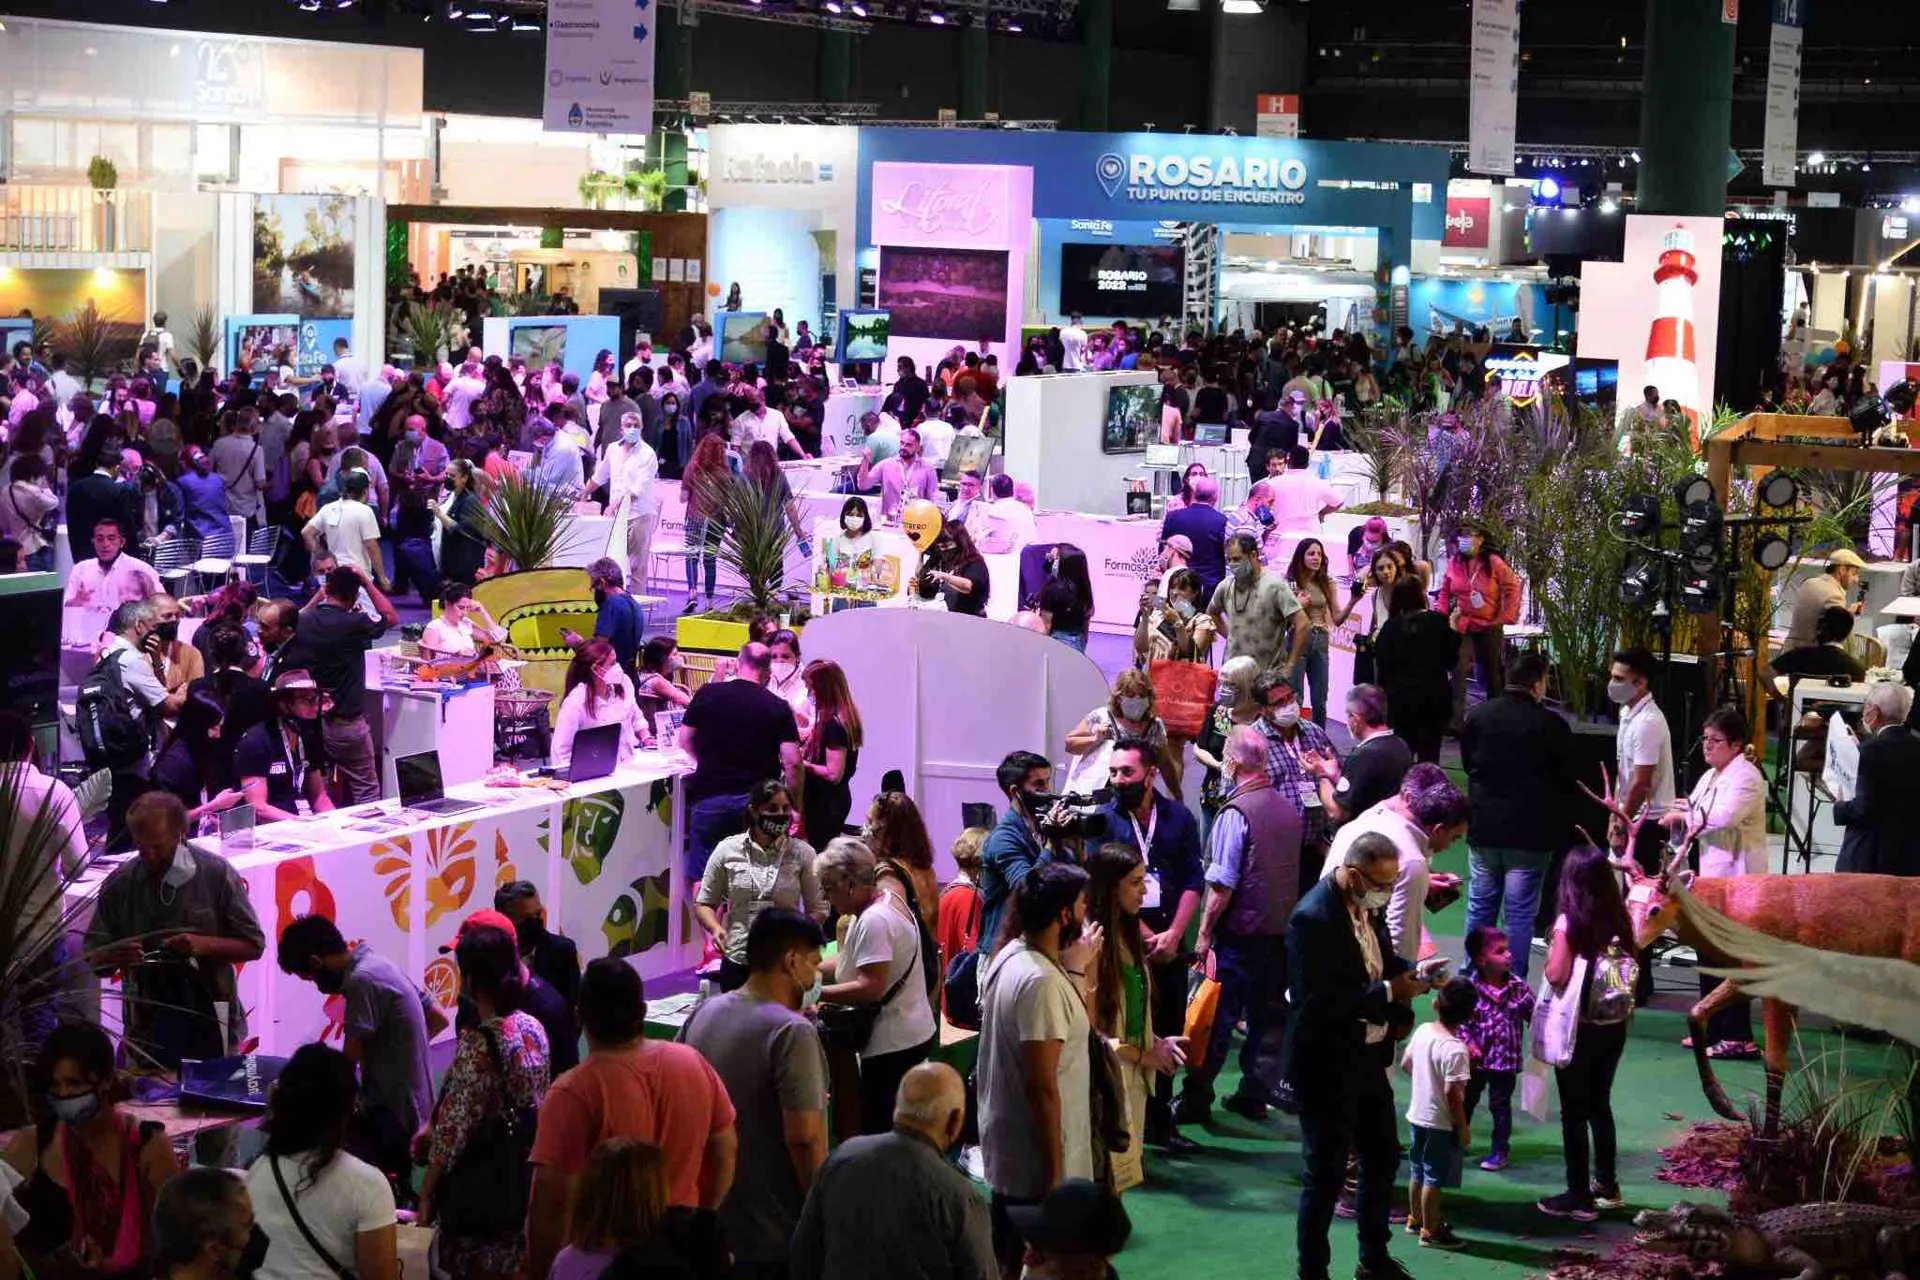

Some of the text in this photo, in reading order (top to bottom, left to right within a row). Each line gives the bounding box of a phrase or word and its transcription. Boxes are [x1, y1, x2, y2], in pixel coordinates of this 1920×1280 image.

[1128, 153, 1307, 190] ROSARIO
[1127, 187, 1305, 205] TU PUNTO DE ENCUENTRO
[1104, 558, 1149, 573] Formosa
